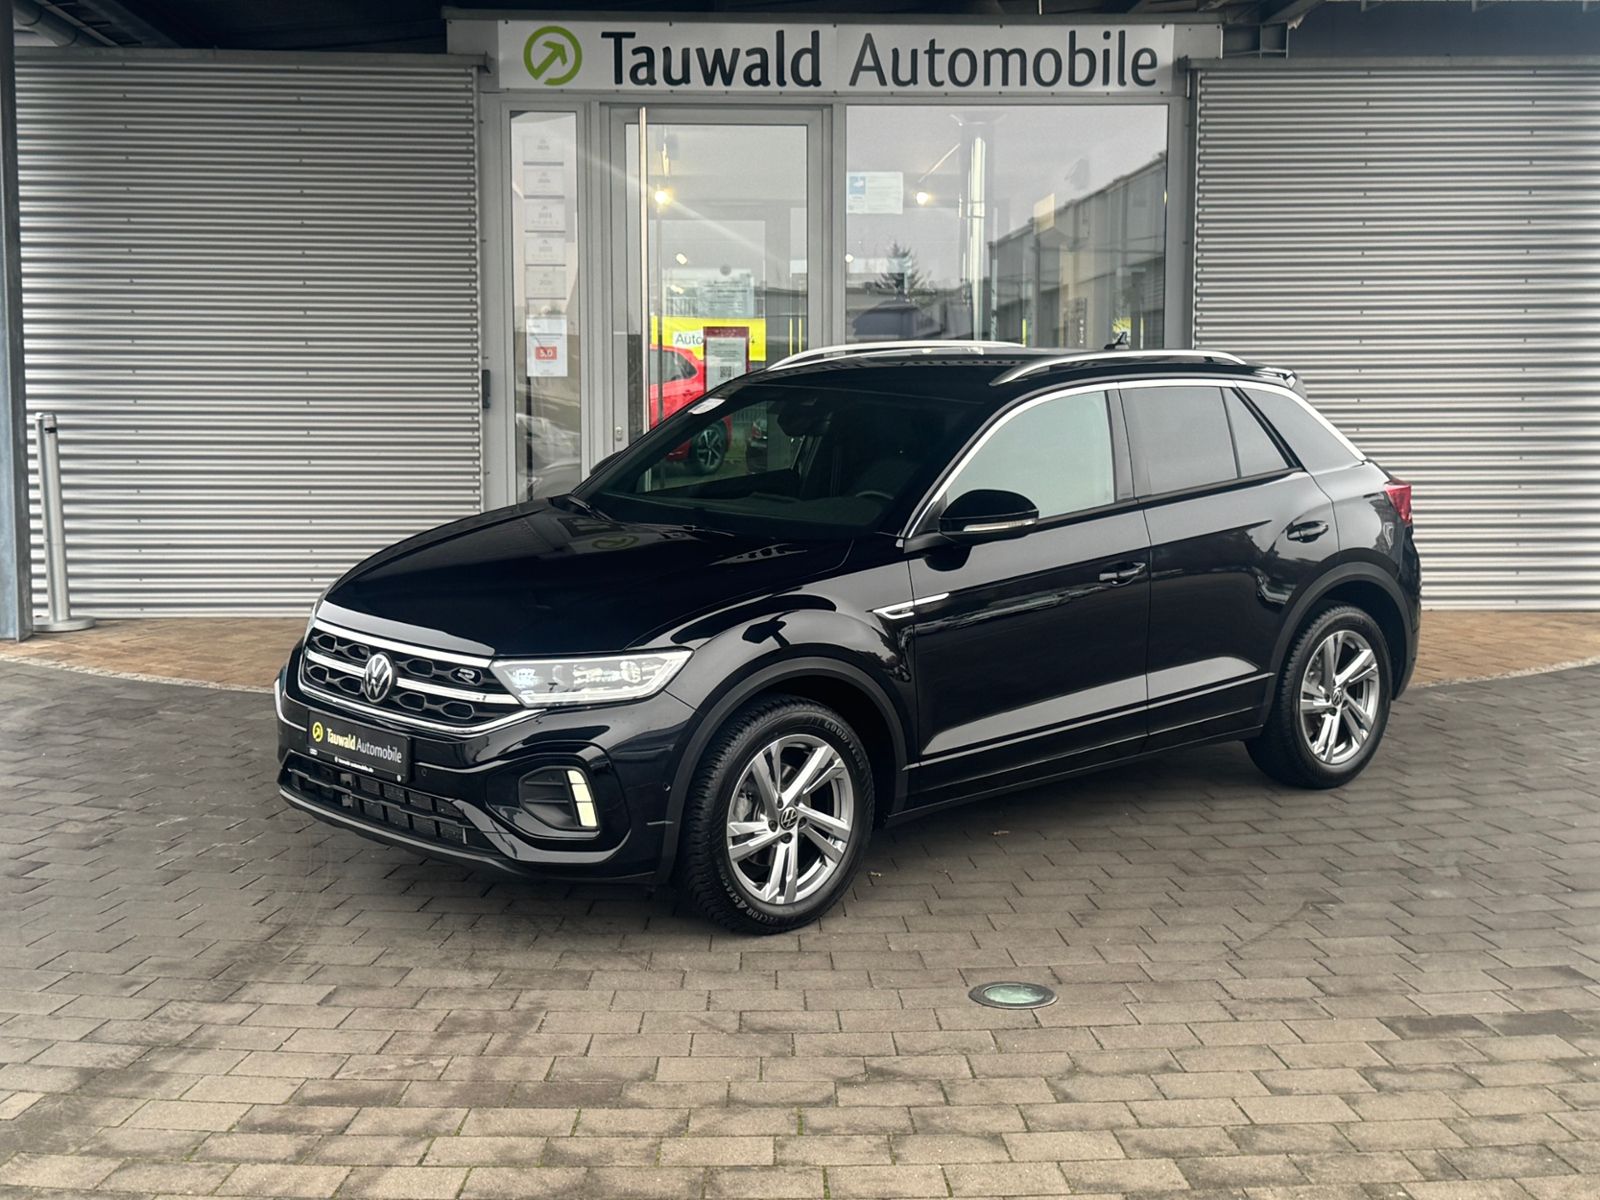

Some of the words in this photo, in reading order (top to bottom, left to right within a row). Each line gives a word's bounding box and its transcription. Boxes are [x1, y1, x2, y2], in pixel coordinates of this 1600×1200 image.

[601, 30, 822, 87] Tauwald
[849, 30, 1158, 87] Automobile
[326, 727, 356, 750] Tauwald
[356, 738, 402, 763] Automobile
